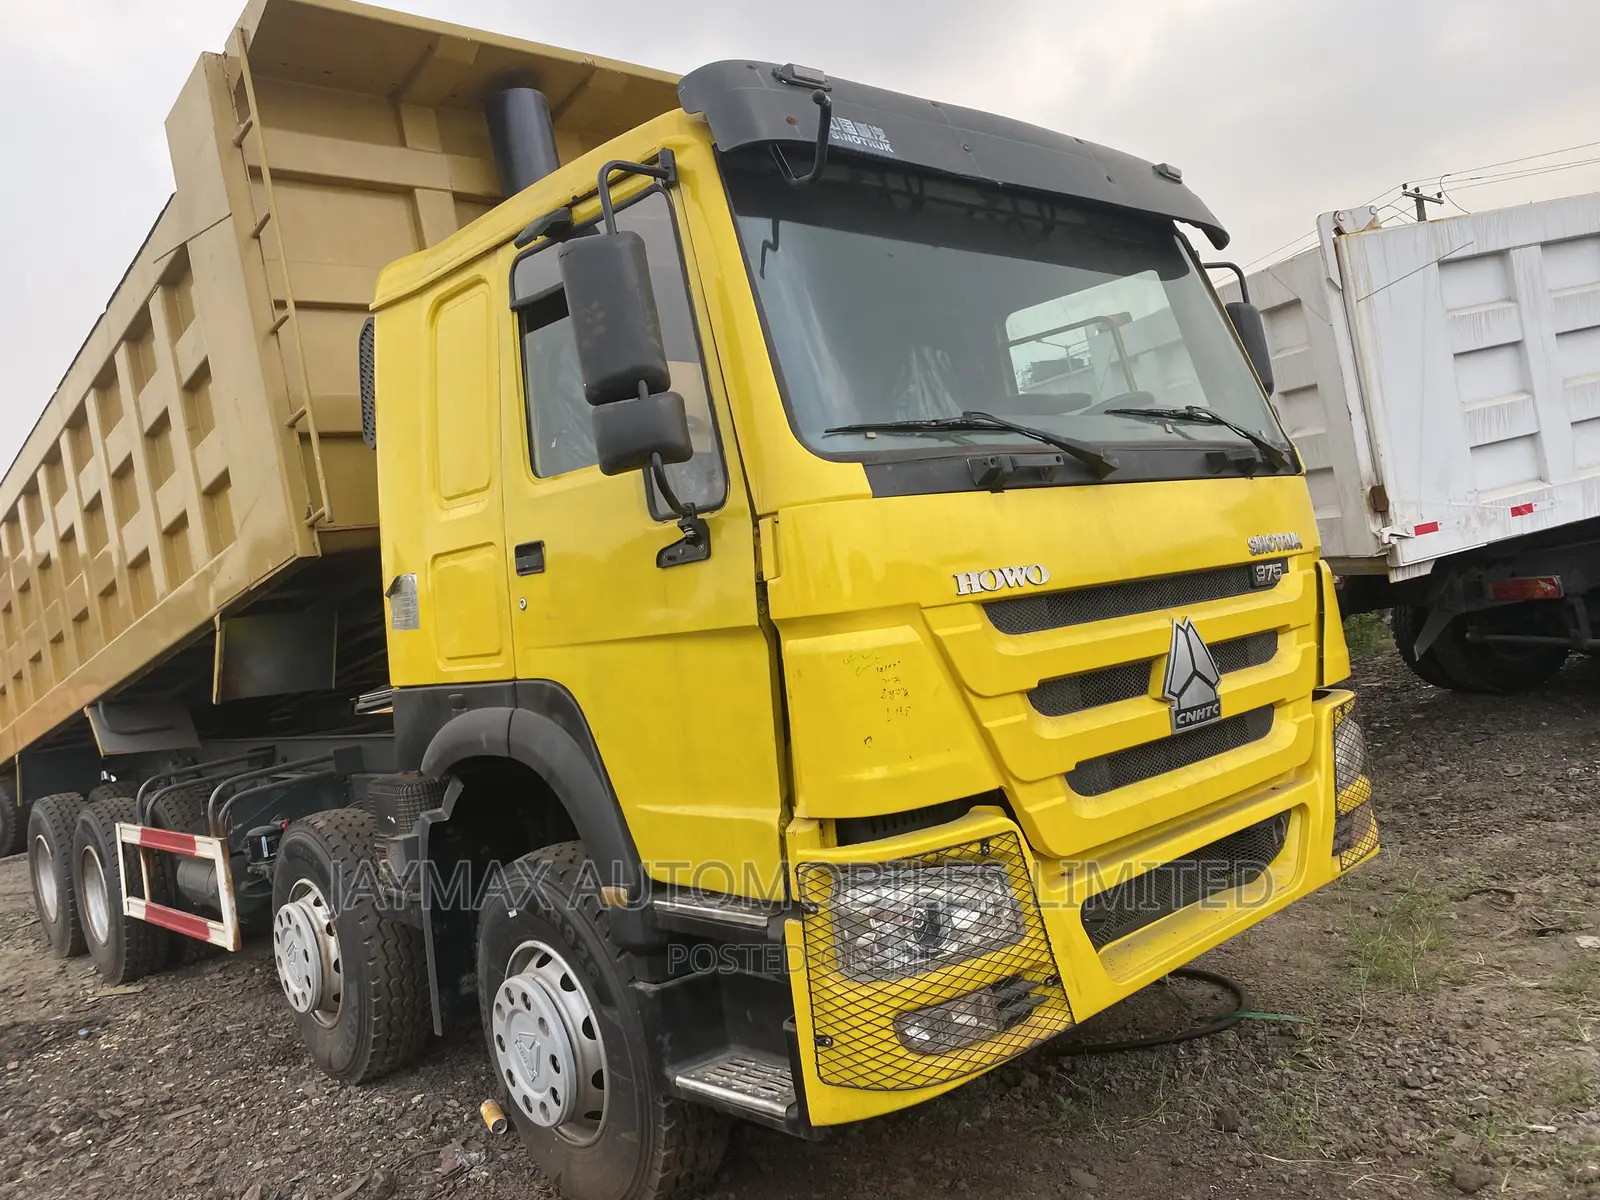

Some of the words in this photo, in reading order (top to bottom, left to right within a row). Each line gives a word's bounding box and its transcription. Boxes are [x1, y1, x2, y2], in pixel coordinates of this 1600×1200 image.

[829, 131, 894, 153] SINOTRUK
[1247, 533, 1302, 556] SINOTRUK
[953, 564, 1050, 596] HOWO
[1256, 563, 1282, 582] 375
[1176, 703, 1220, 725] CNHTC
